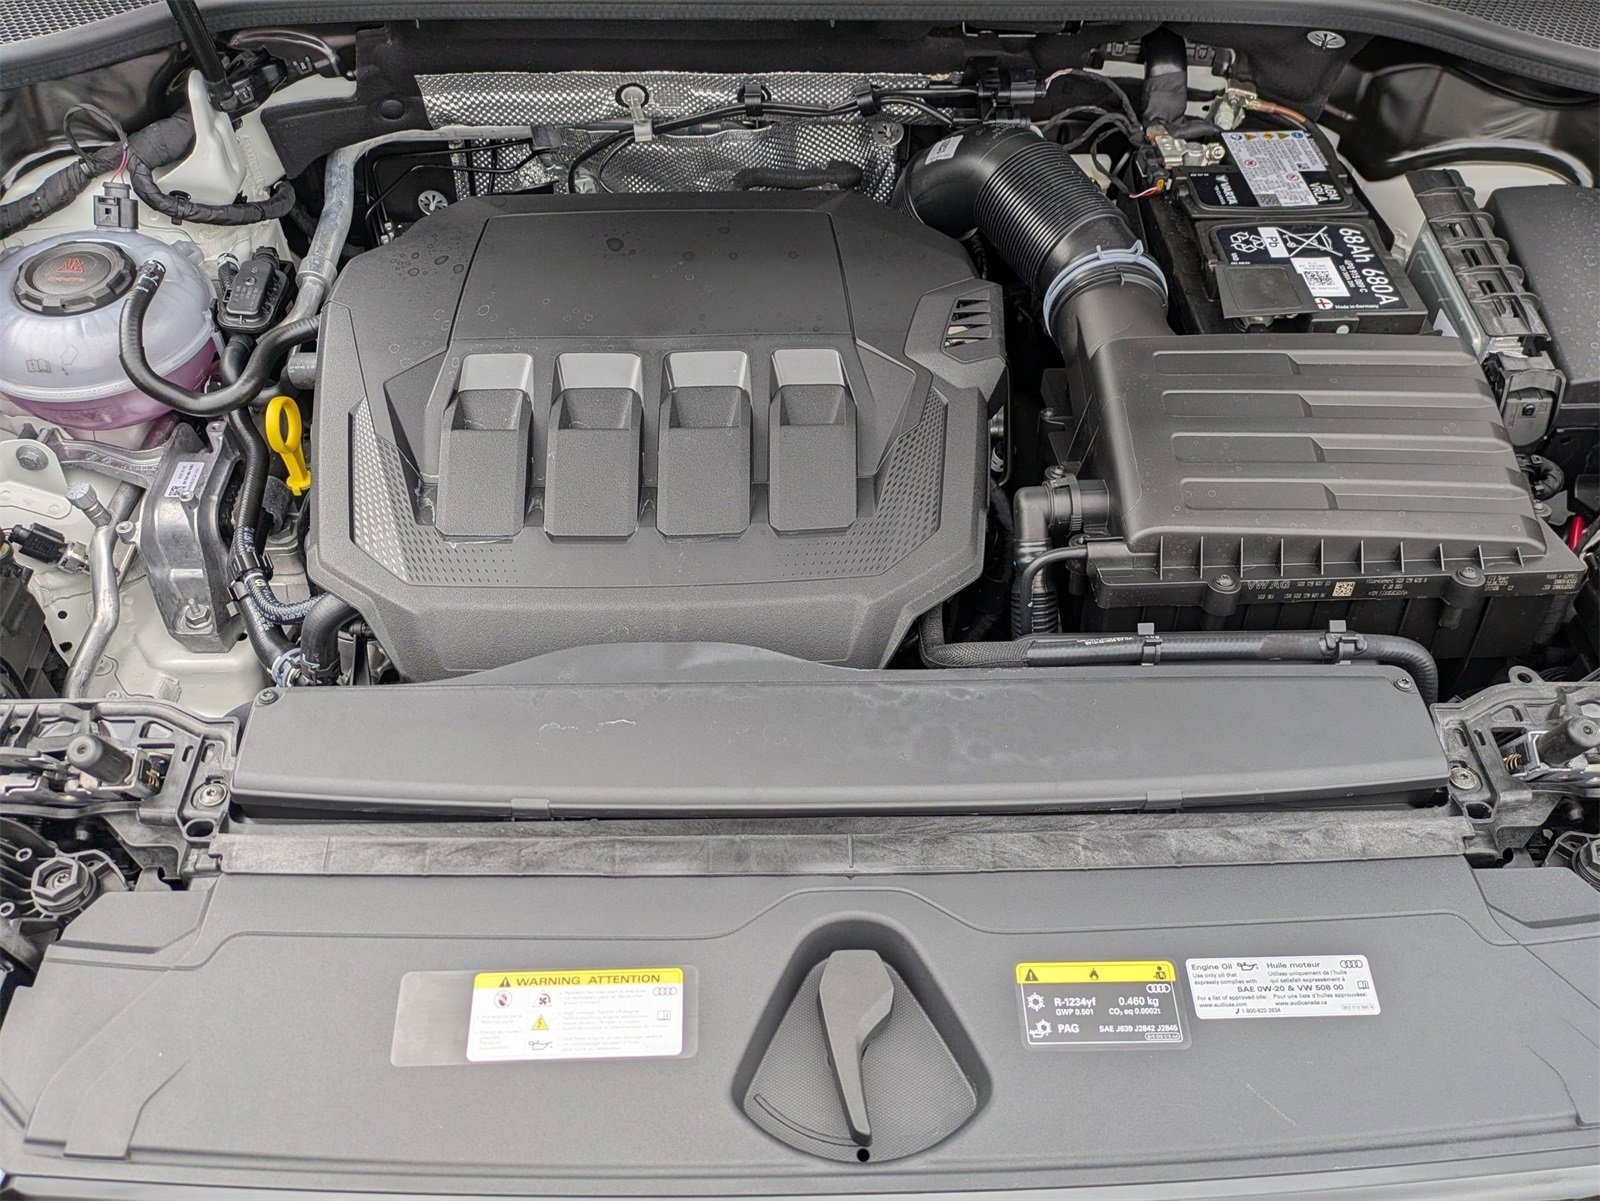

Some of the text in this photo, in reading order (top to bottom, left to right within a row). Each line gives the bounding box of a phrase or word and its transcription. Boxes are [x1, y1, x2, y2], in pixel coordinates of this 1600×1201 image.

[1221, 183, 1238, 205] VARTA
[1309, 182, 1328, 202] VRLA
[1322, 184, 1341, 200] AGM
[1265, 236, 1278, 248] Pb
[1339, 228, 1399, 304] 68Ah 680A
[1248, 580, 1291, 590] VW AG
[1191, 963, 1220, 971] Engine
[516, 974, 661, 986] WARNING ATTENTION
[1054, 997, 1159, 1008] R-1234yf 0.460 kg
[1056, 1008, 1094, 1016] GWP 0.501
[1134, 1007, 1162, 1015] 0.0002t
[1058, 1024, 1080, 1033] PAG
[1099, 1025, 1115, 1033] SAE
[1157, 1024, 1178, 1032] J2845
